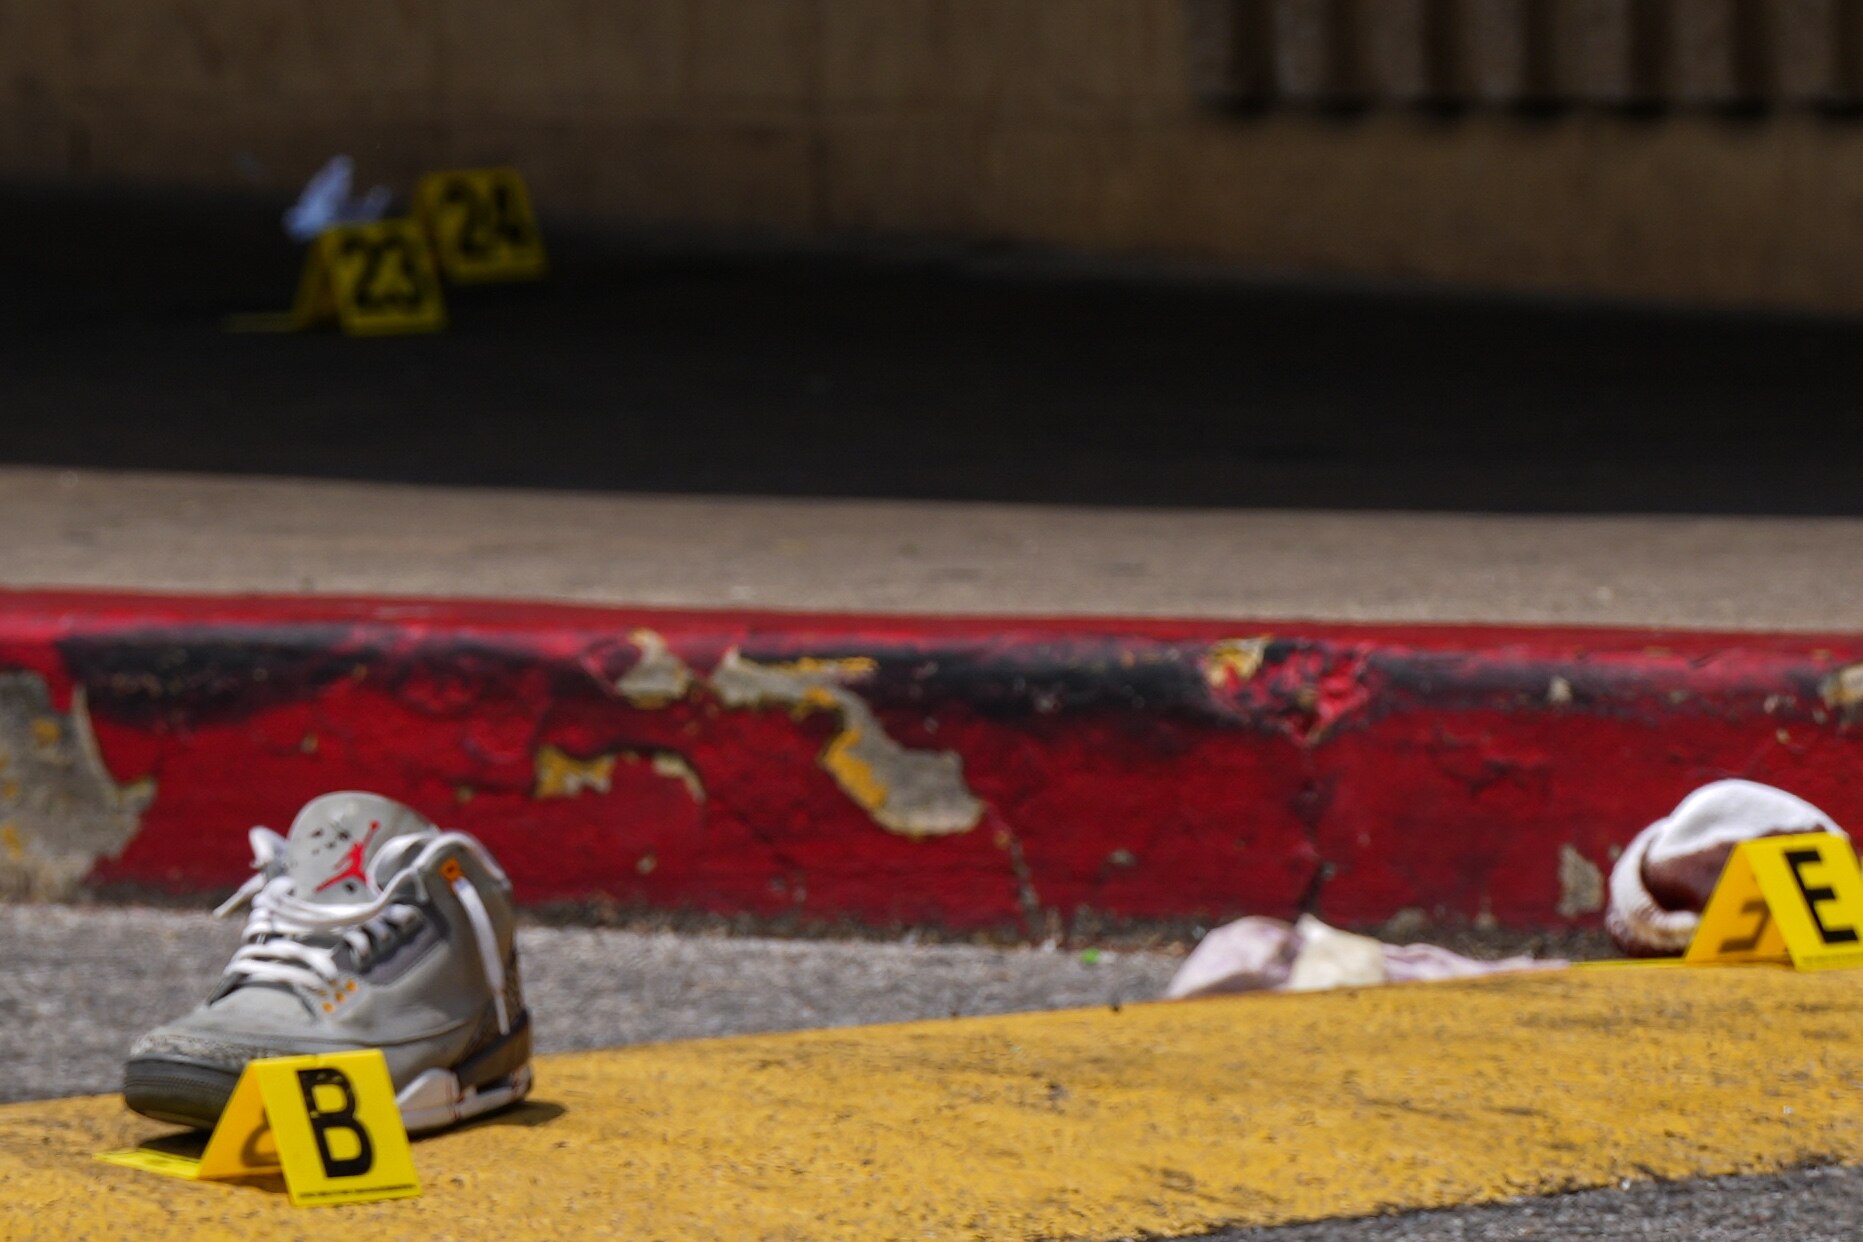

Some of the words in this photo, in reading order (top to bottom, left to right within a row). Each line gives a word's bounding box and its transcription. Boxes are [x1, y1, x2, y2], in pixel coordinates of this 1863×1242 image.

[445, 179, 525, 254] 24
[340, 234, 421, 309] 23
[1783, 848, 1860, 944] E
[296, 1067, 375, 1178] B
